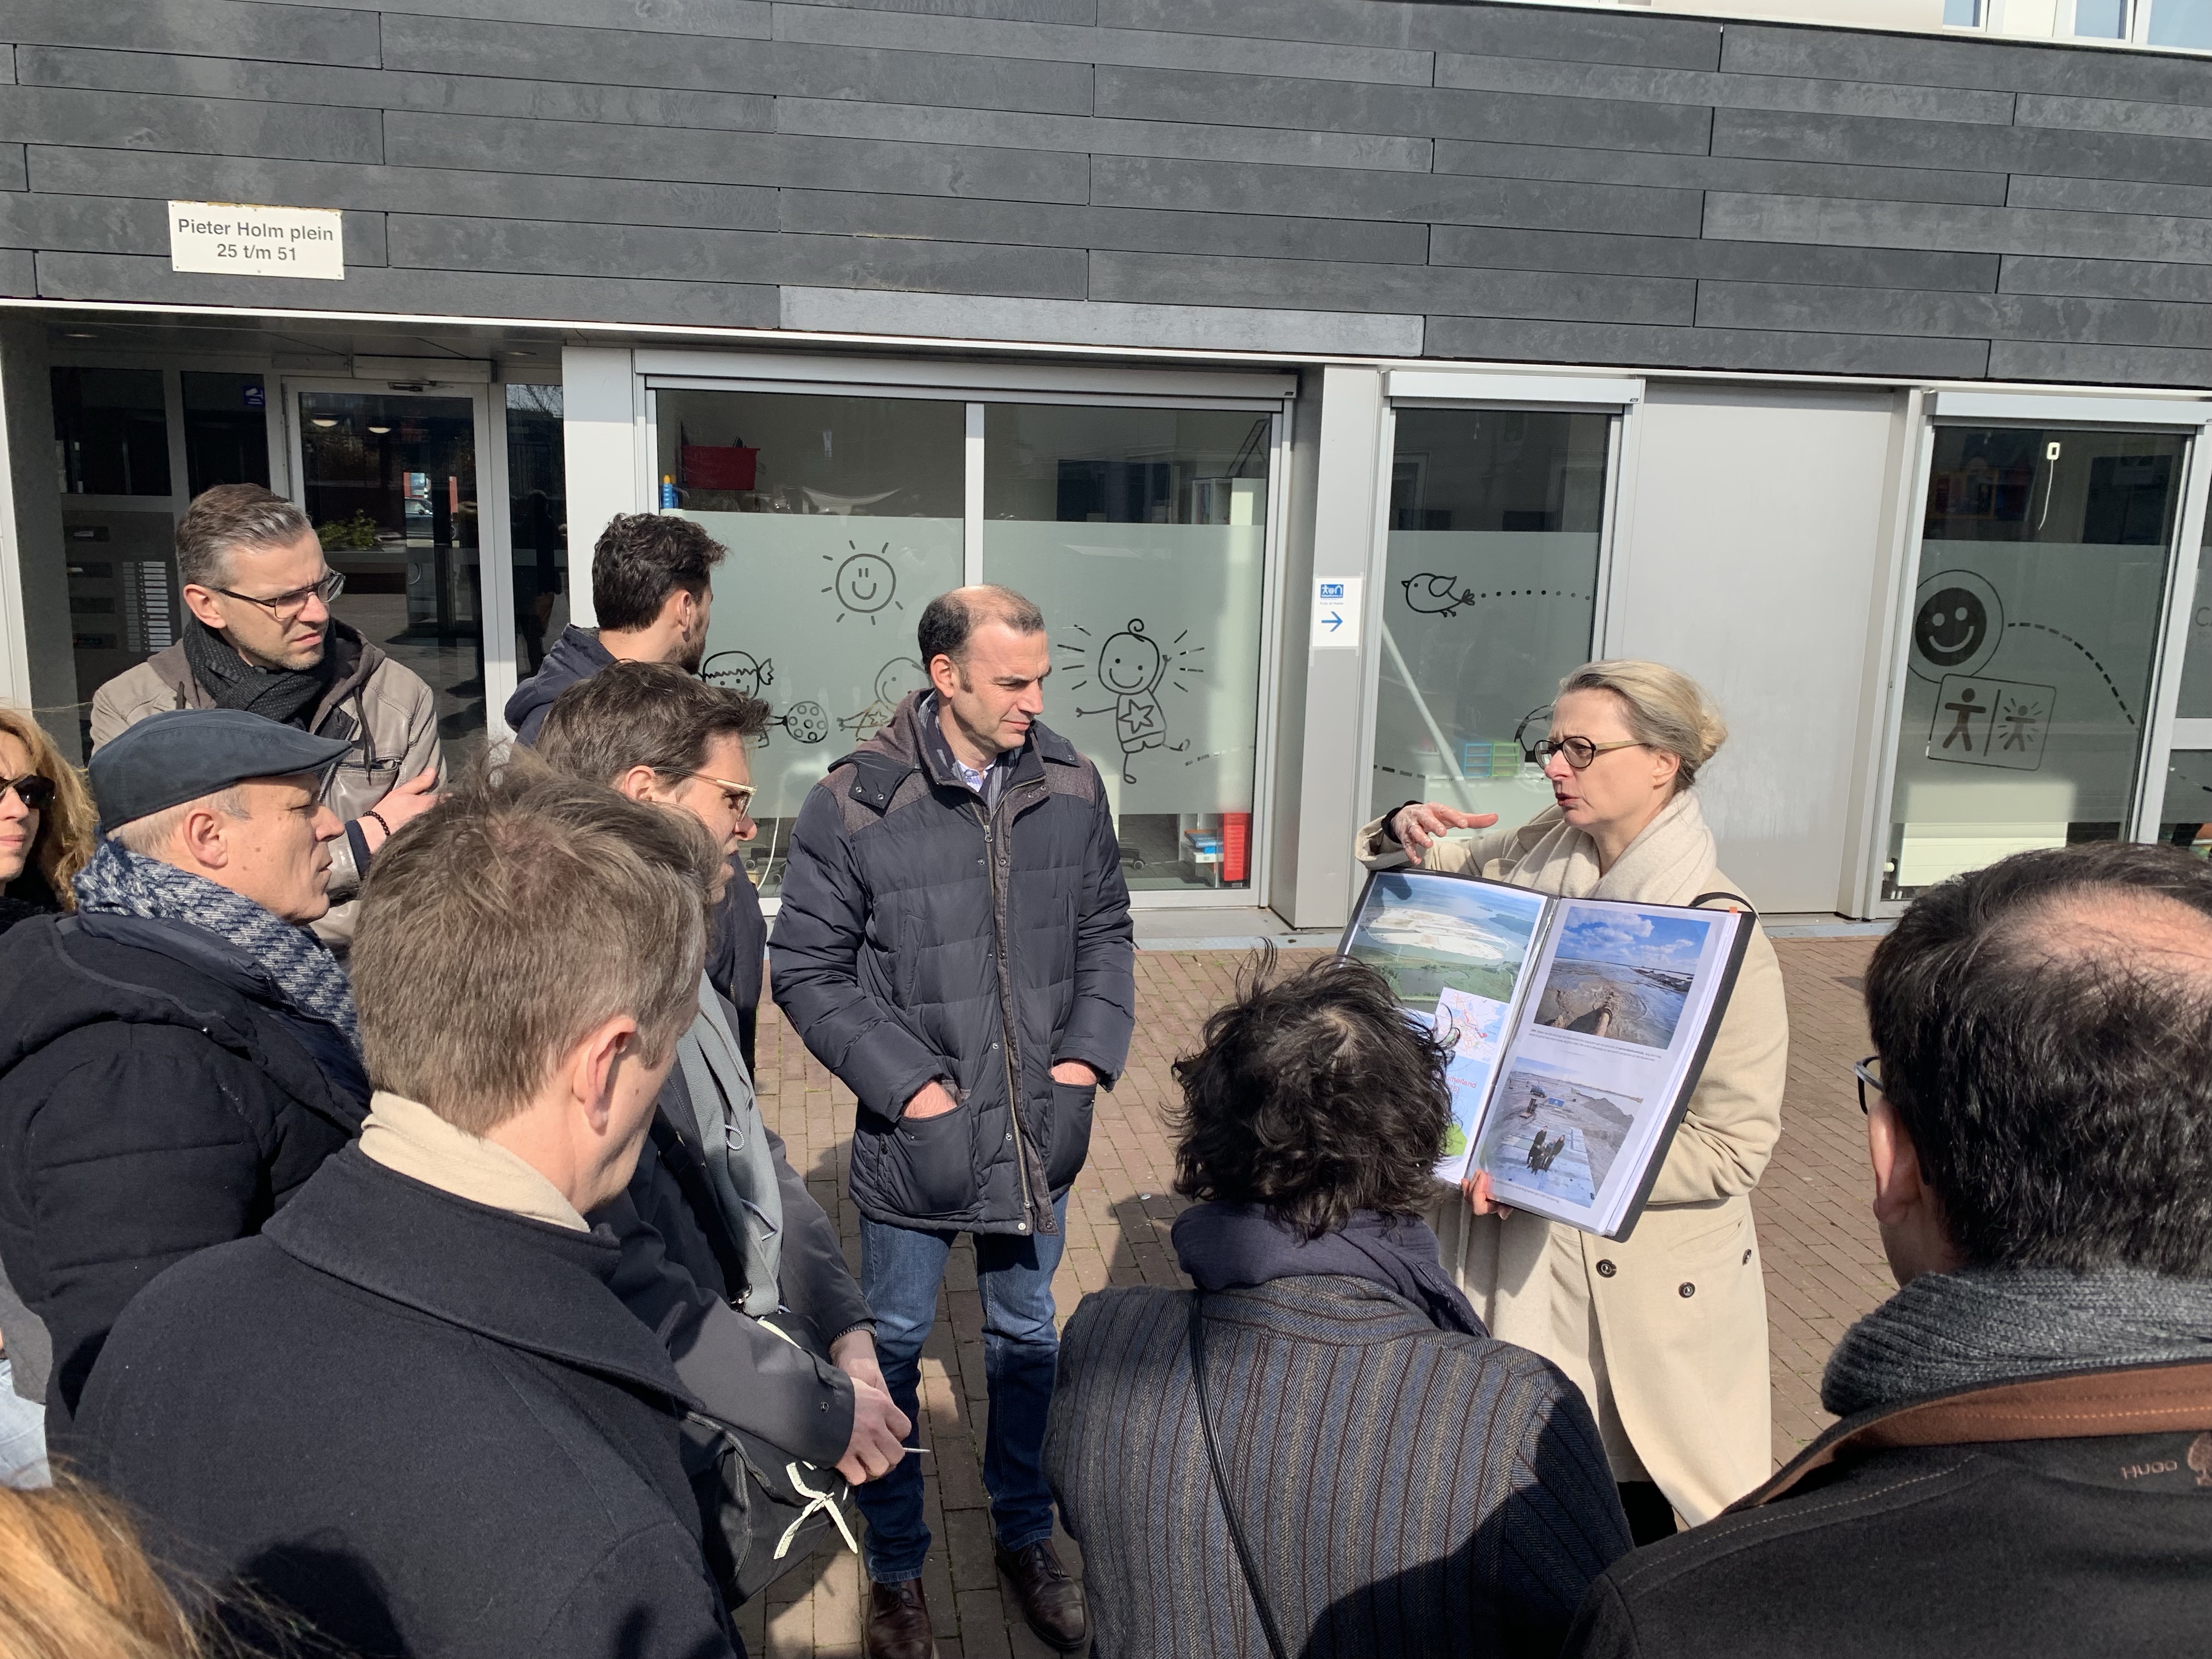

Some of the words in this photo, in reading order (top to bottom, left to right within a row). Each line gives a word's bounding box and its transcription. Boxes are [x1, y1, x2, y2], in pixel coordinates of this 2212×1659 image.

[178, 219, 230, 236] Pieter
[238, 222, 284, 238] Holm
[291, 225, 334, 242] plein
[217, 244, 237, 258] 25
[244, 245, 272, 260] t/m
[278, 247, 296, 261] 51
[2120, 1460, 2177, 1480] HUGO
